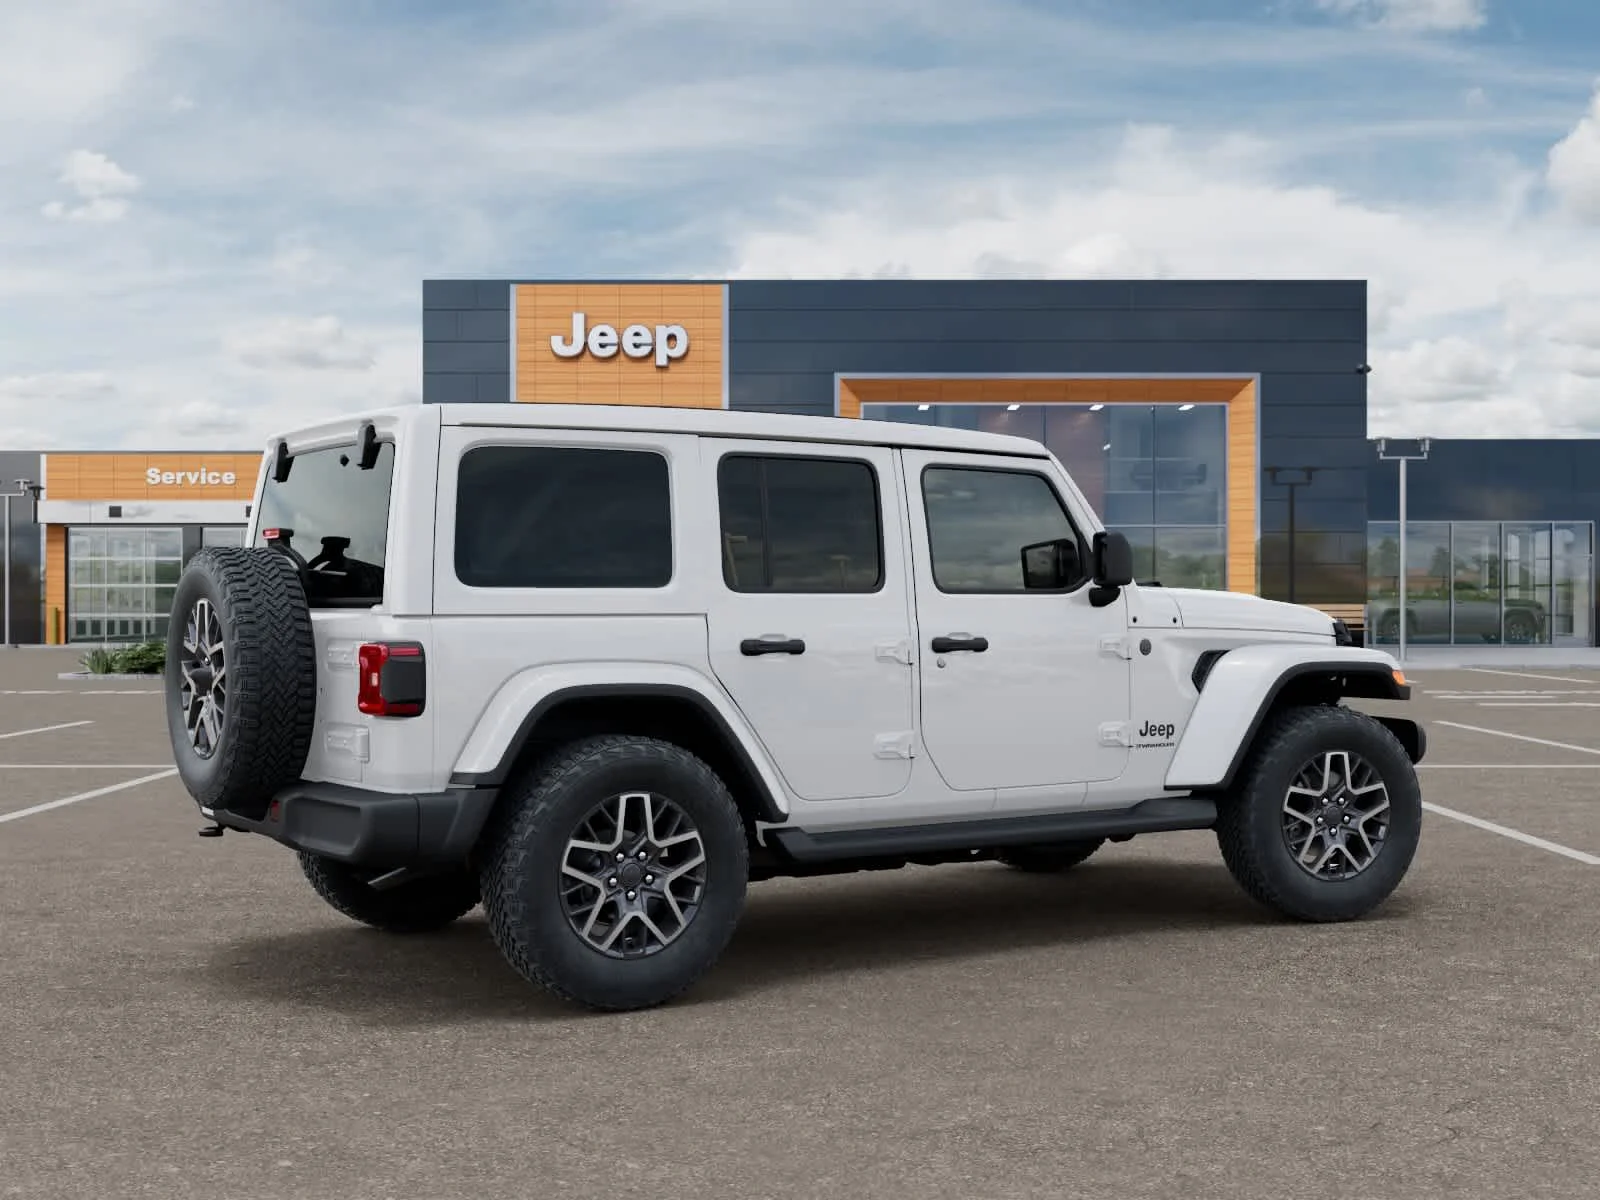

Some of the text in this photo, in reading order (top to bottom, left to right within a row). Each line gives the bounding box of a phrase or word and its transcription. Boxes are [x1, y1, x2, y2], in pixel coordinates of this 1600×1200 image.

[550, 312, 689, 367] Jeep
[146, 466, 237, 485] Service
[1138, 720, 1175, 739] Jeep
